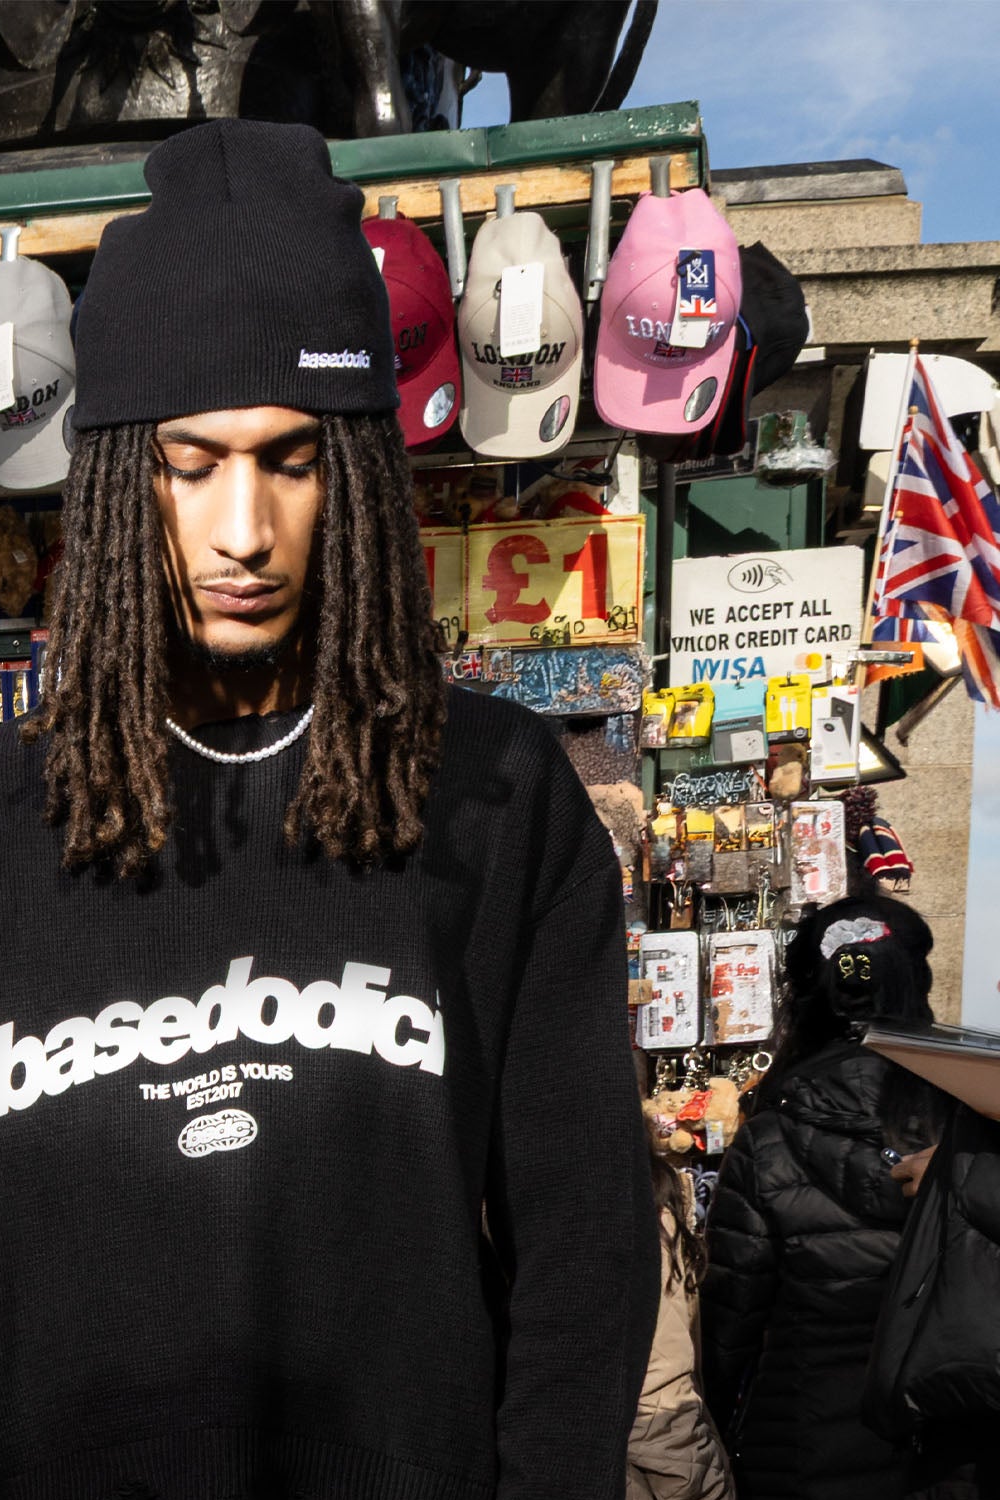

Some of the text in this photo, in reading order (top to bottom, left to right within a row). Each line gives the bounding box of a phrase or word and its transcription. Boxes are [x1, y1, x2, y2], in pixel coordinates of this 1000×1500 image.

[493, 380, 541, 389] ENGLAND
[482, 530, 608, 625] £1
[689, 599, 832, 627] WE ACCEPT ALL
[735, 628, 798, 649] CREDIT
[805, 624, 852, 643] CARD
[139, 1063, 293, 1101] THE WORLD IS YOURS
